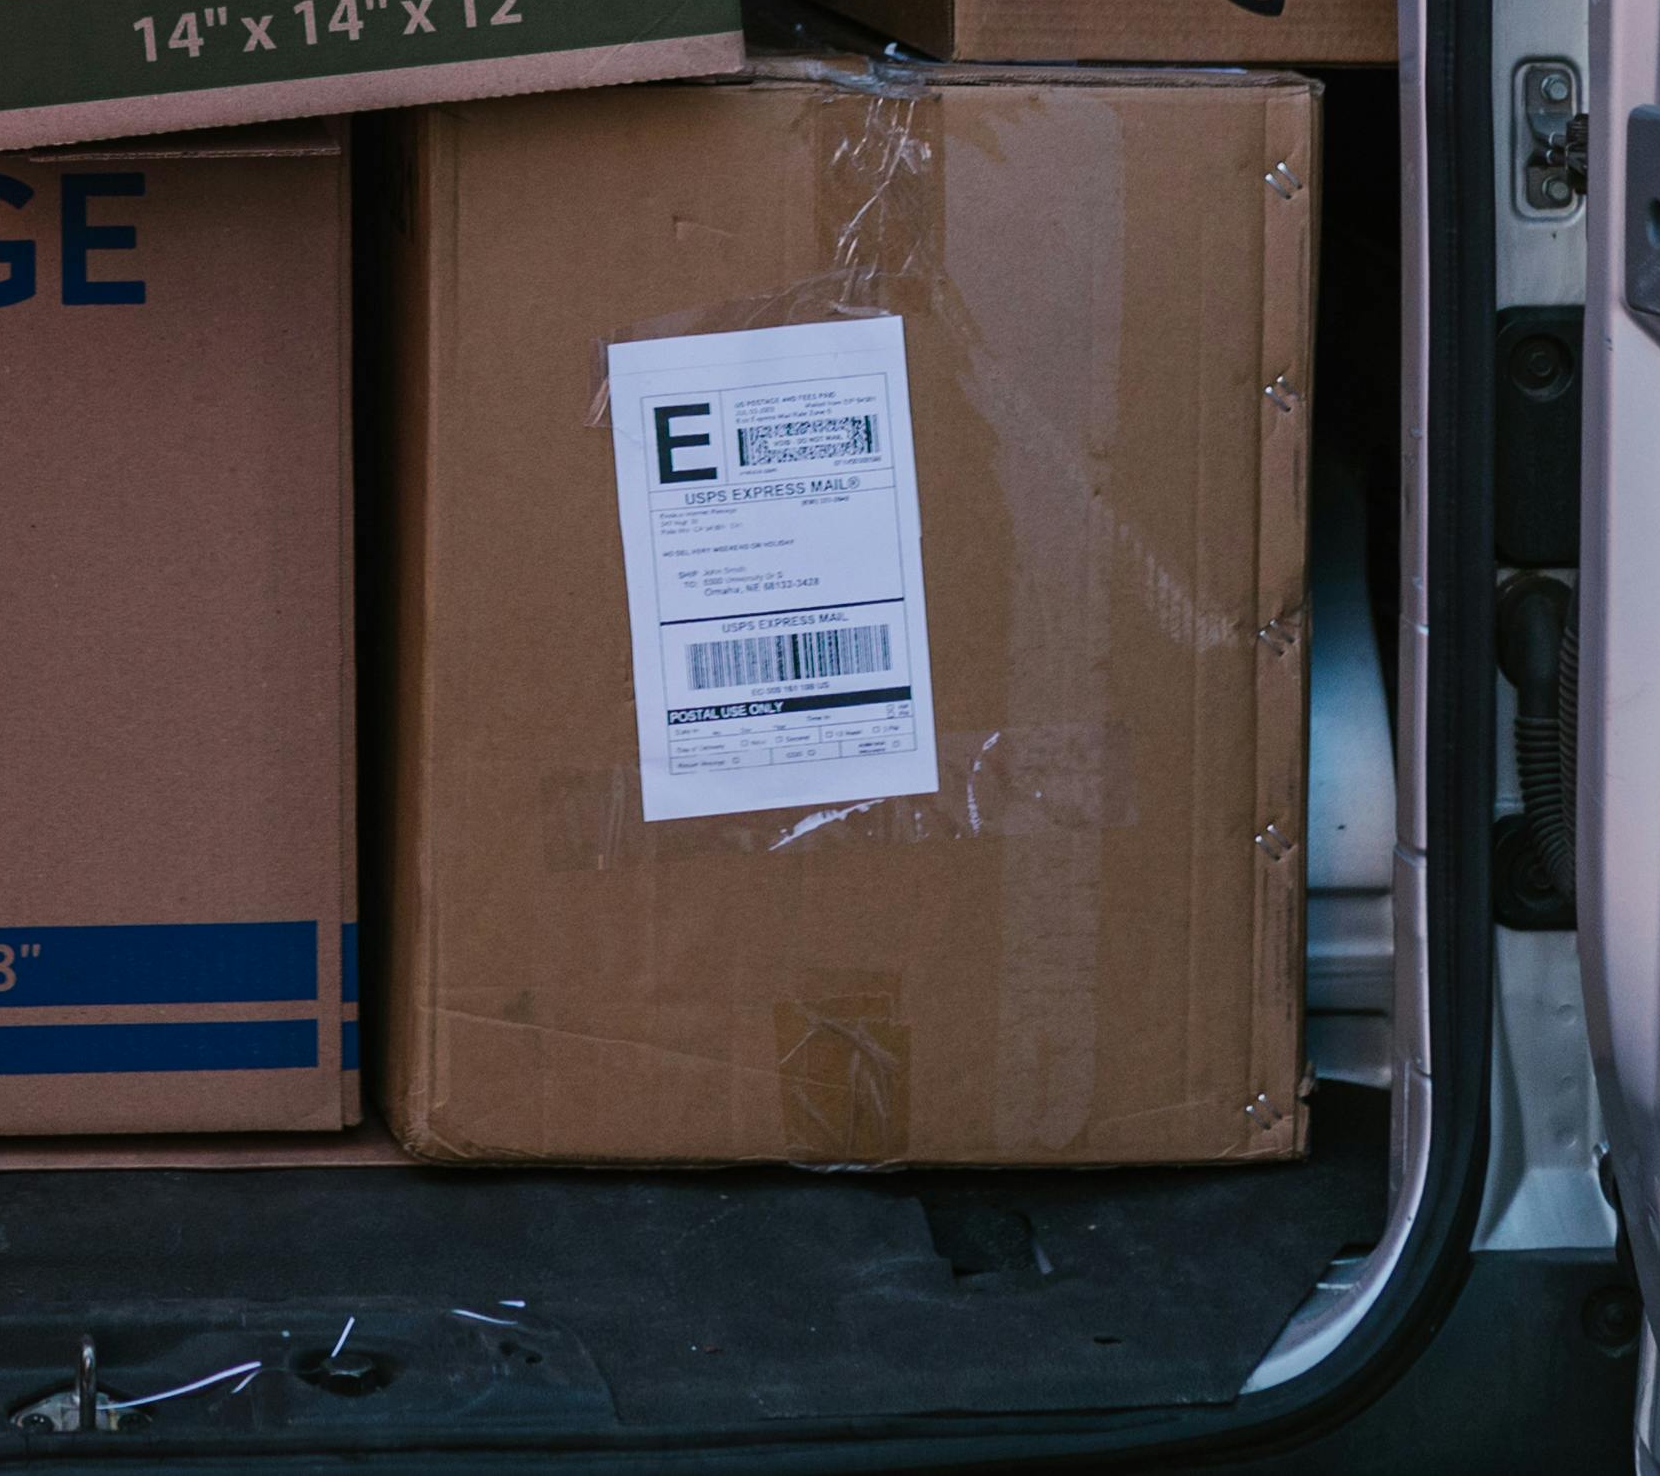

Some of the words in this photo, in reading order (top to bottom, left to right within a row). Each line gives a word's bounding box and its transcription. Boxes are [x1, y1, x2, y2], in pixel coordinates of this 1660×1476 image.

[134, 7, 229, 65] 14"
[242, 16, 277, 53] x
[653, 402, 717, 484] E
[685, 490, 727, 504] USPS
[732, 482, 805, 499] EXPRESS
[704, 586, 743, 597] Omaha,
[746, 583, 759, 592] NE
[722, 621, 754, 632] USPS
[758, 615, 815, 629] EXPRESS
[819, 611, 848, 623] MAIL
[669, 707, 719, 723] POSTAL
[720, 704, 746, 717] USE
[748, 700, 784, 714] ONLY
